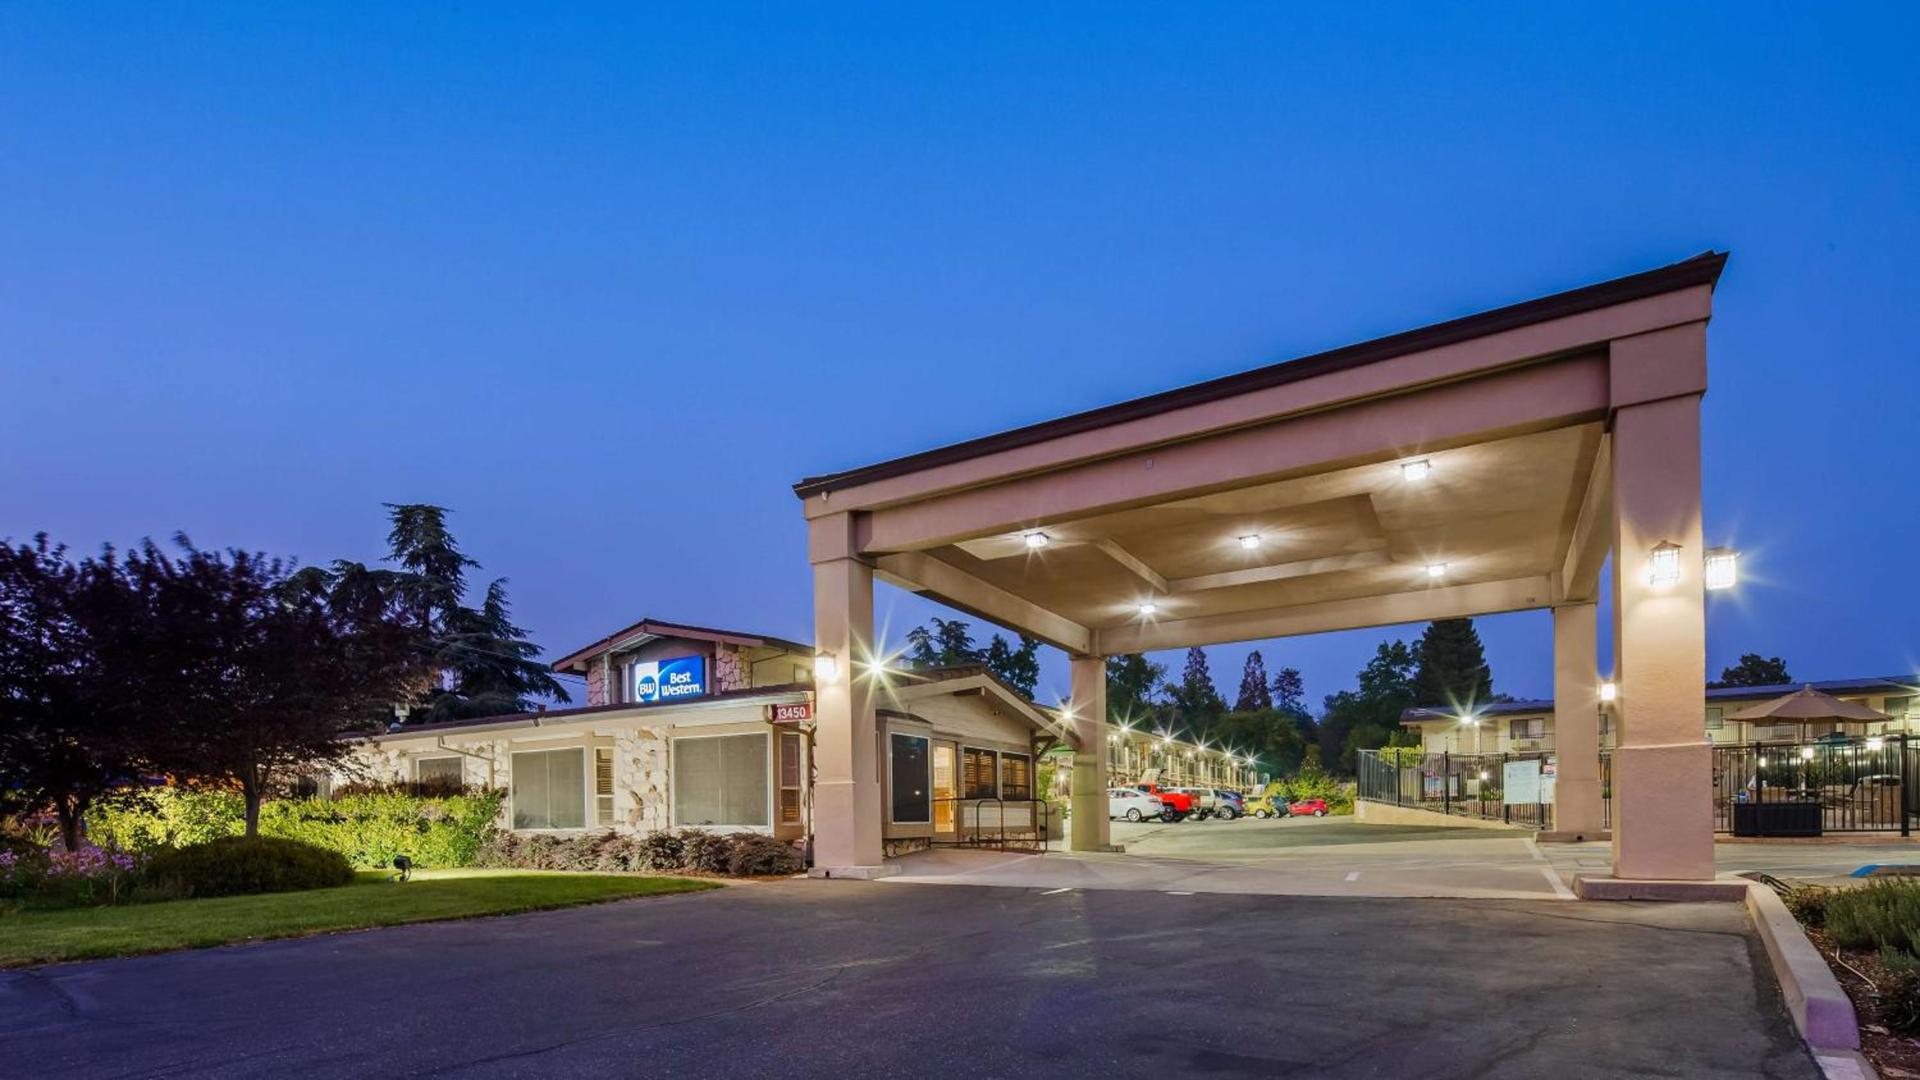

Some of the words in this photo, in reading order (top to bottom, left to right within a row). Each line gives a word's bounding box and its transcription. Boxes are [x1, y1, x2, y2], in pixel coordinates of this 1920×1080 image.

[670, 672, 691, 684] Best
[639, 682, 655, 695] BW
[777, 706, 806, 719] 13450
